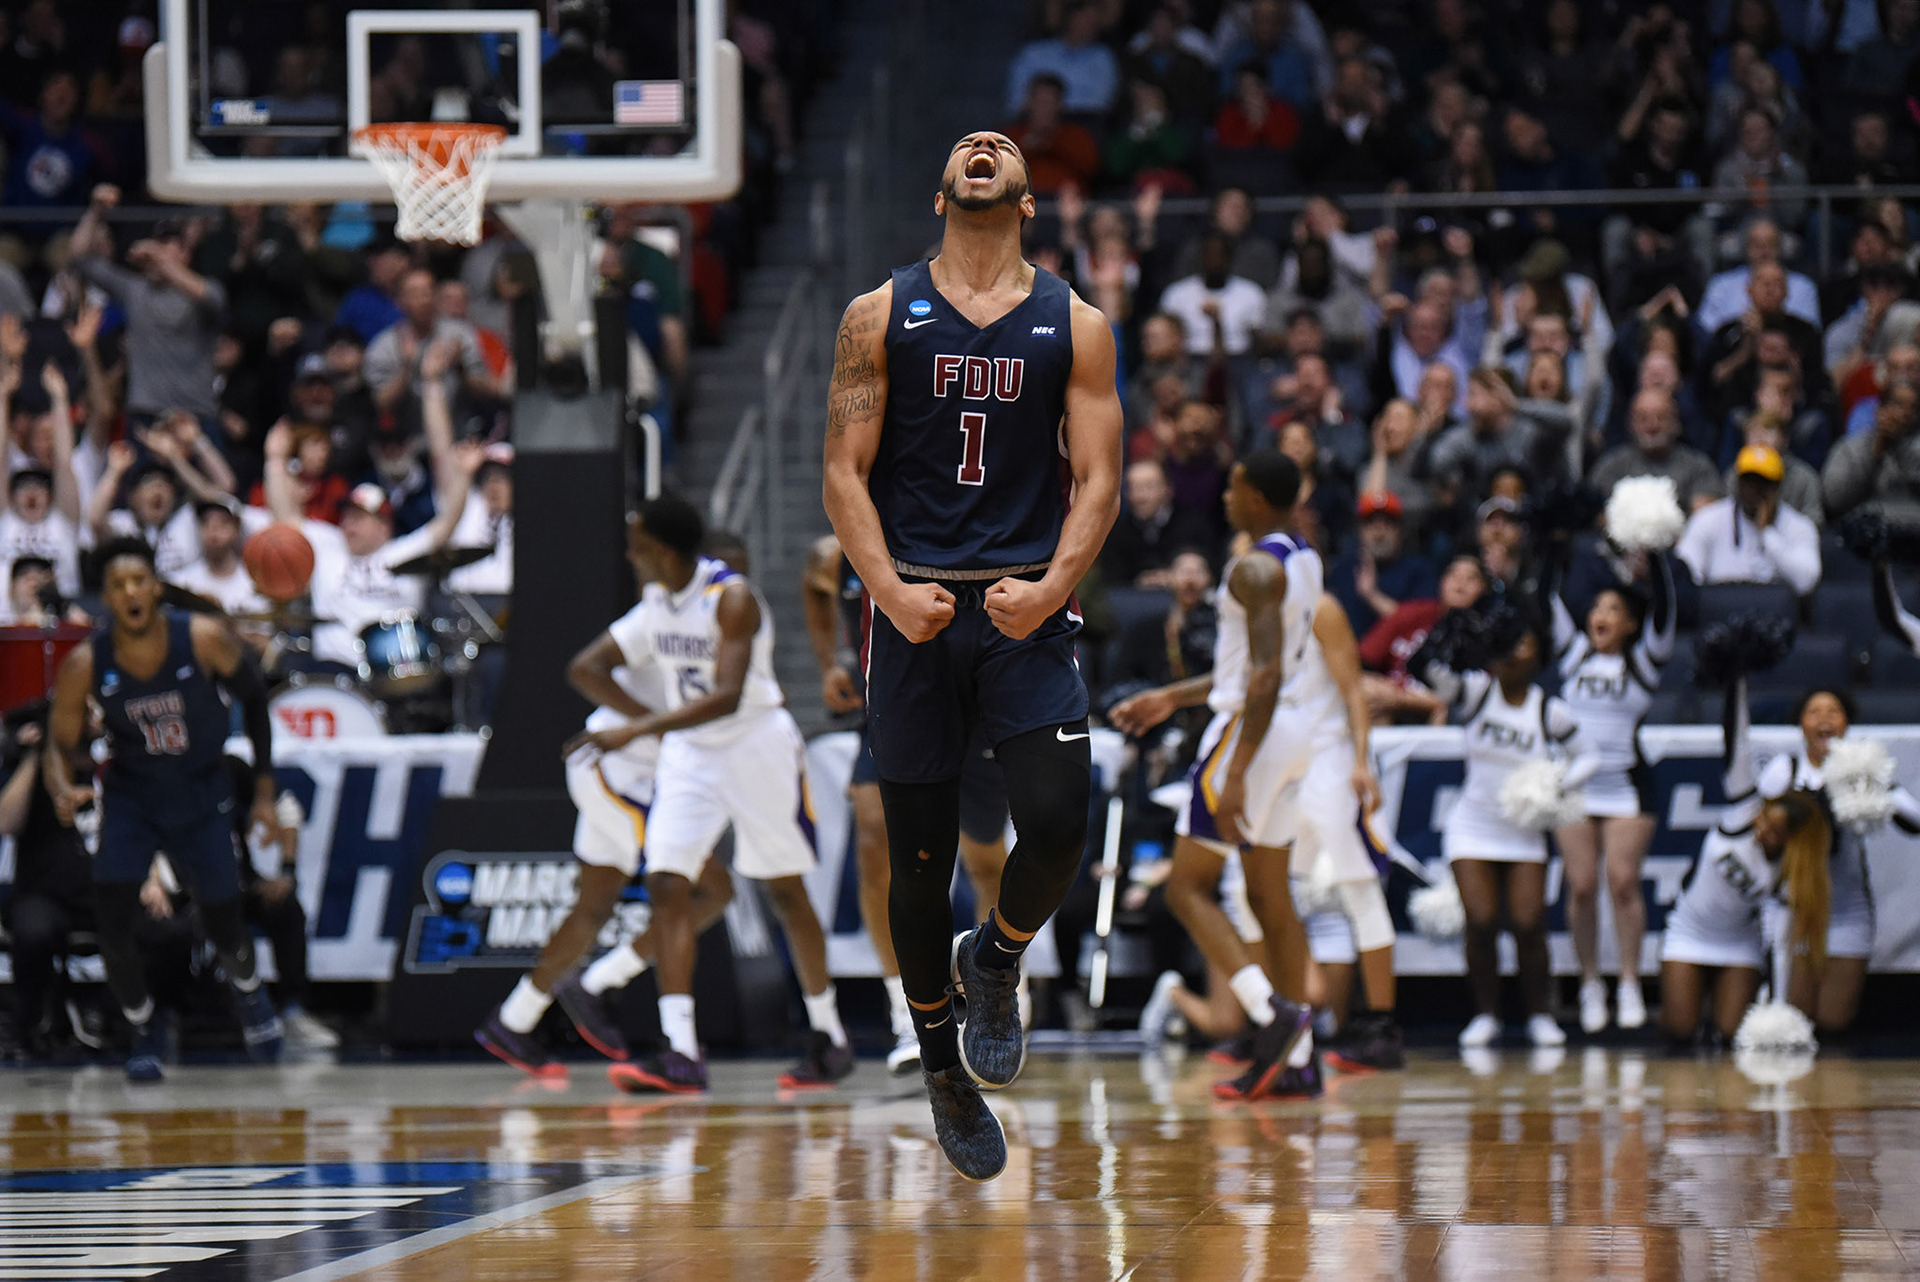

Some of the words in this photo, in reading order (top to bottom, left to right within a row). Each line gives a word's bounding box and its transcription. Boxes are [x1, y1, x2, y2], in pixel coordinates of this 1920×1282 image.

[1031, 326, 1056, 335] NEC
[934, 354, 1025, 402] FDU
[957, 411, 987, 487] 1
[677, 665, 710, 703] 15
[1577, 675, 1627, 699] FDU
[124, 690, 185, 724] FDU
[1480, 721, 1535, 751] FDU
[470, 861, 582, 907] MARC
